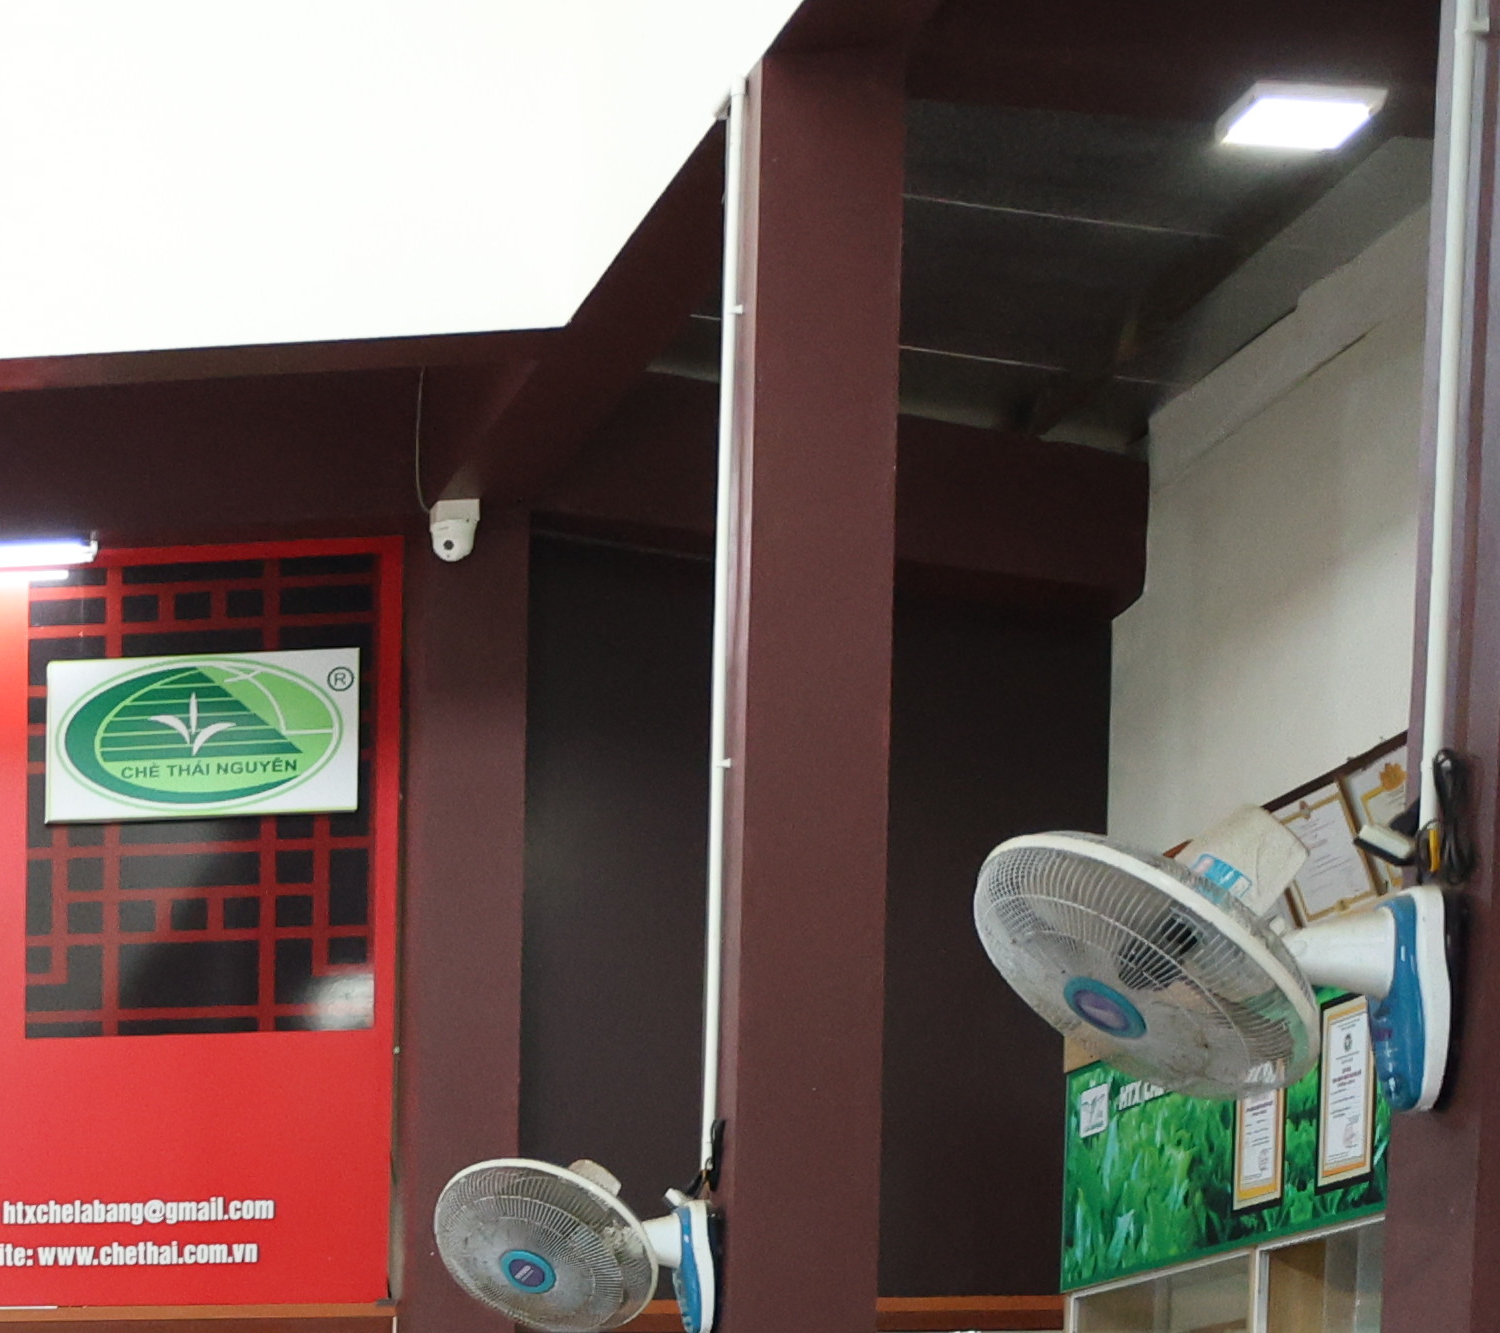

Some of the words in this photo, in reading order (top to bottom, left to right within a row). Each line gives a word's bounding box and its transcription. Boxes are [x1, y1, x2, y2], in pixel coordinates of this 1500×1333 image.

[121, 764, 159, 779] CHÈ
[166, 761, 210, 777] THÁI
[217, 757, 297, 774] NGUYÊN
[2, 1197, 275, 1225] htxchelabang@gmail.com
[37, 1240, 259, 1267] www.chethai.com.vn
